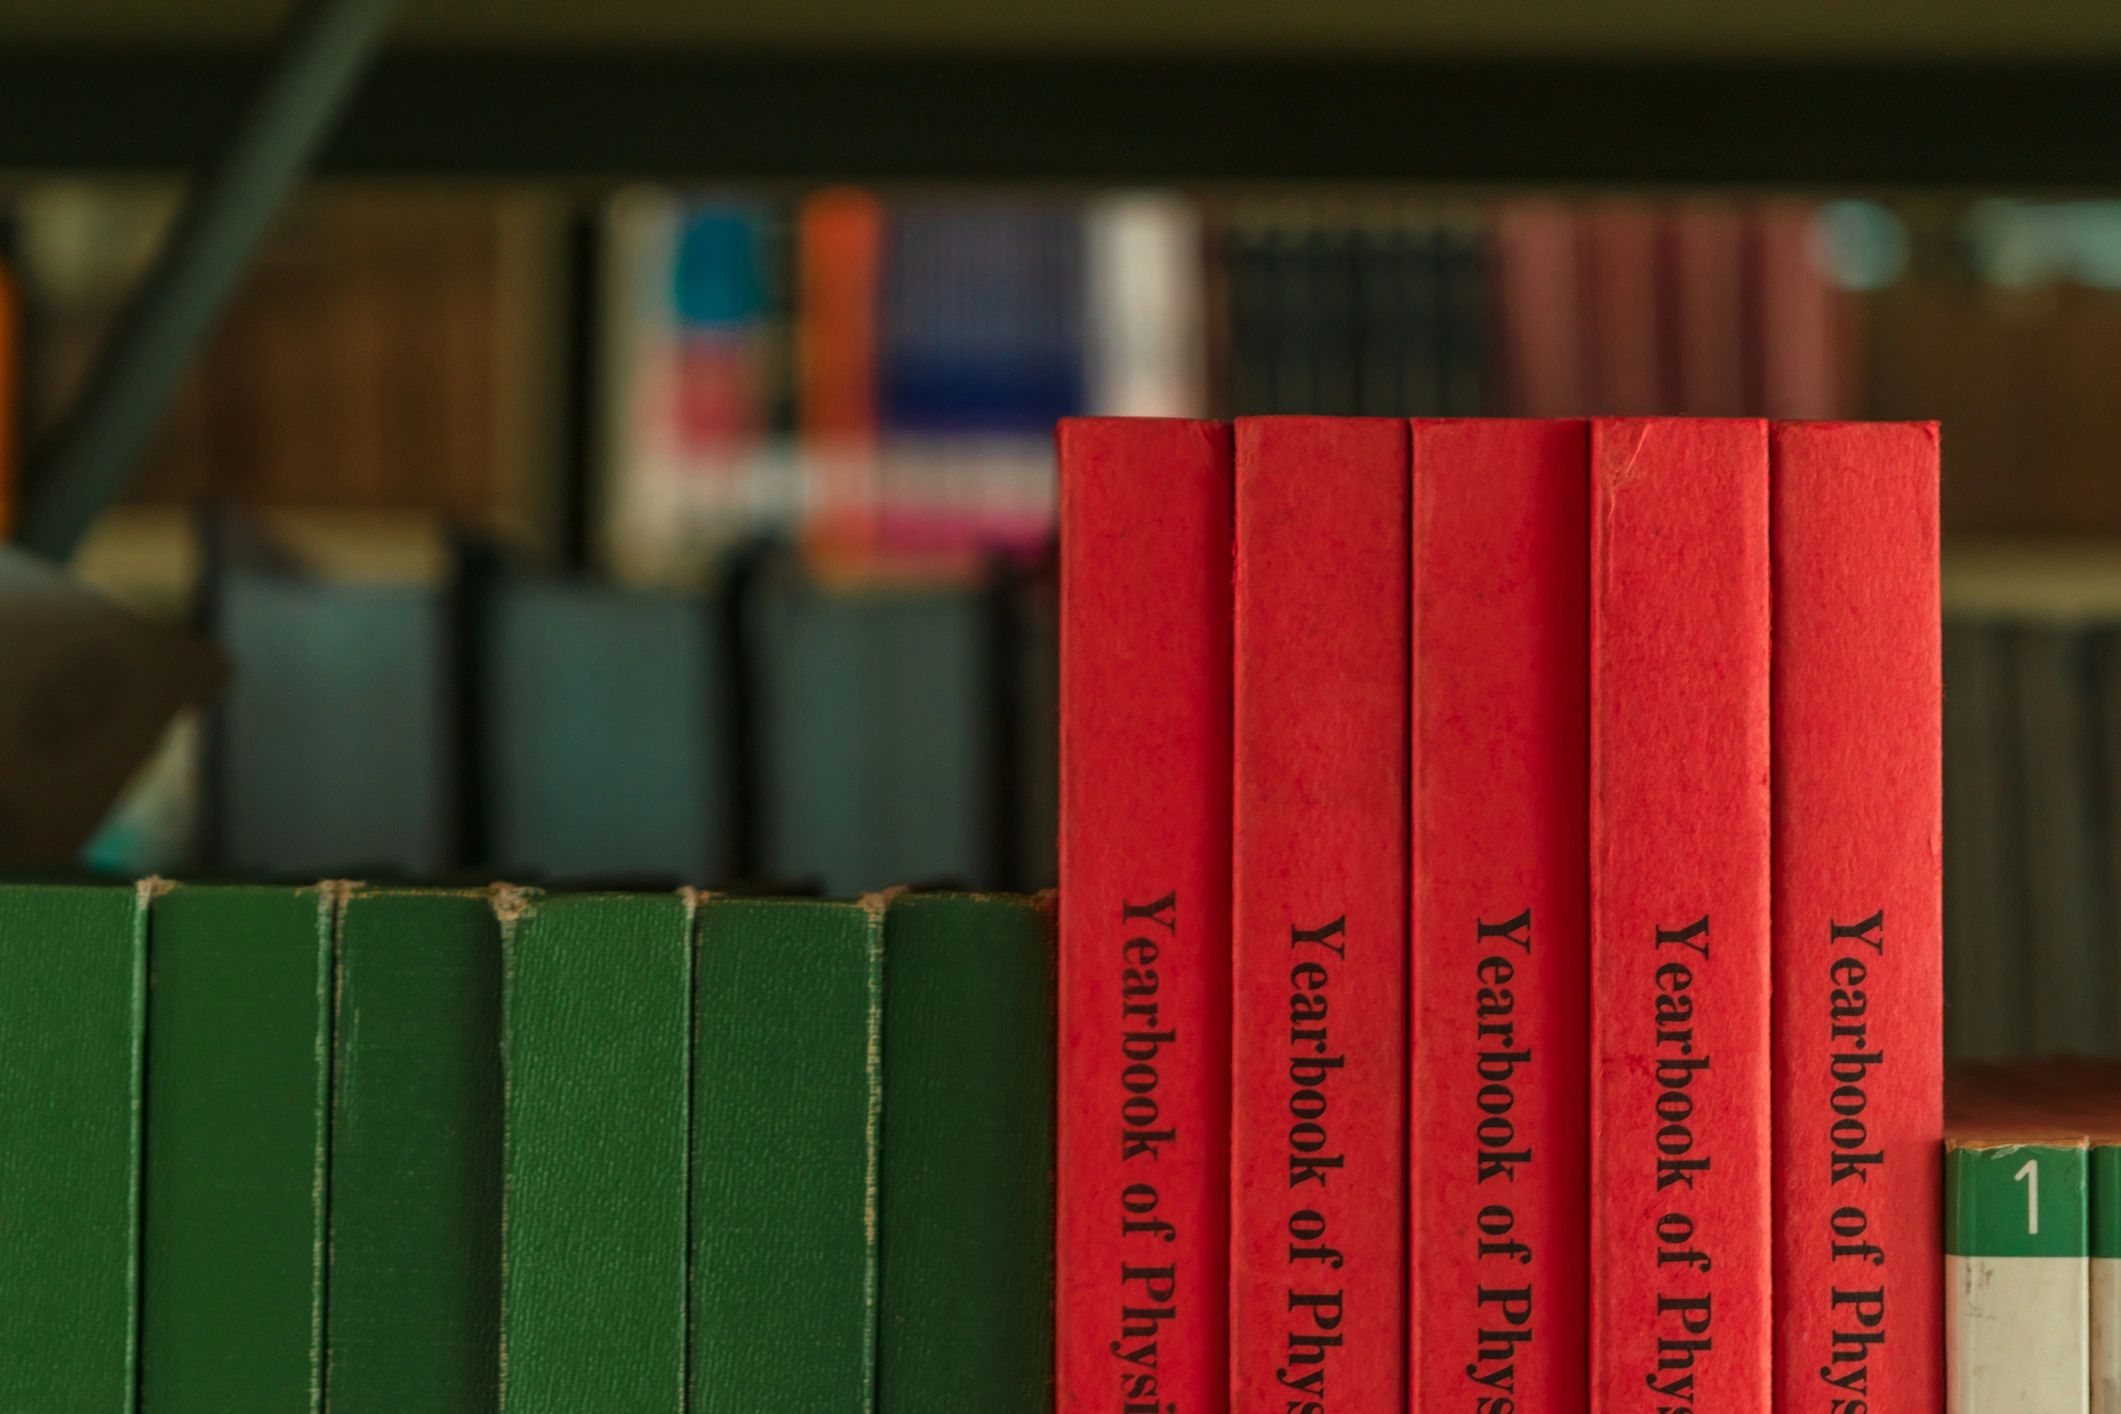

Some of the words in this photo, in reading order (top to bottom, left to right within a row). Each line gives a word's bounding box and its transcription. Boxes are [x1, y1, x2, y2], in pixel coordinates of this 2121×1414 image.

[1121, 890, 1177, 1162] Yearbook
[1288, 913, 1346, 1189] Yearbook
[1476, 907, 1533, 1186] Yearbook
[1654, 913, 1711, 1193] Yearbook
[1829, 909, 1884, 1186] Yearbook
[1120, 1182, 1177, 1244] of
[1475, 1203, 1533, 1266] of
[2013, 1159, 2039, 1235] 1
[1287, 1208, 1346, 1270] of
[1655, 1212, 1712, 1274] of
[1829, 1205, 1885, 1267] of
